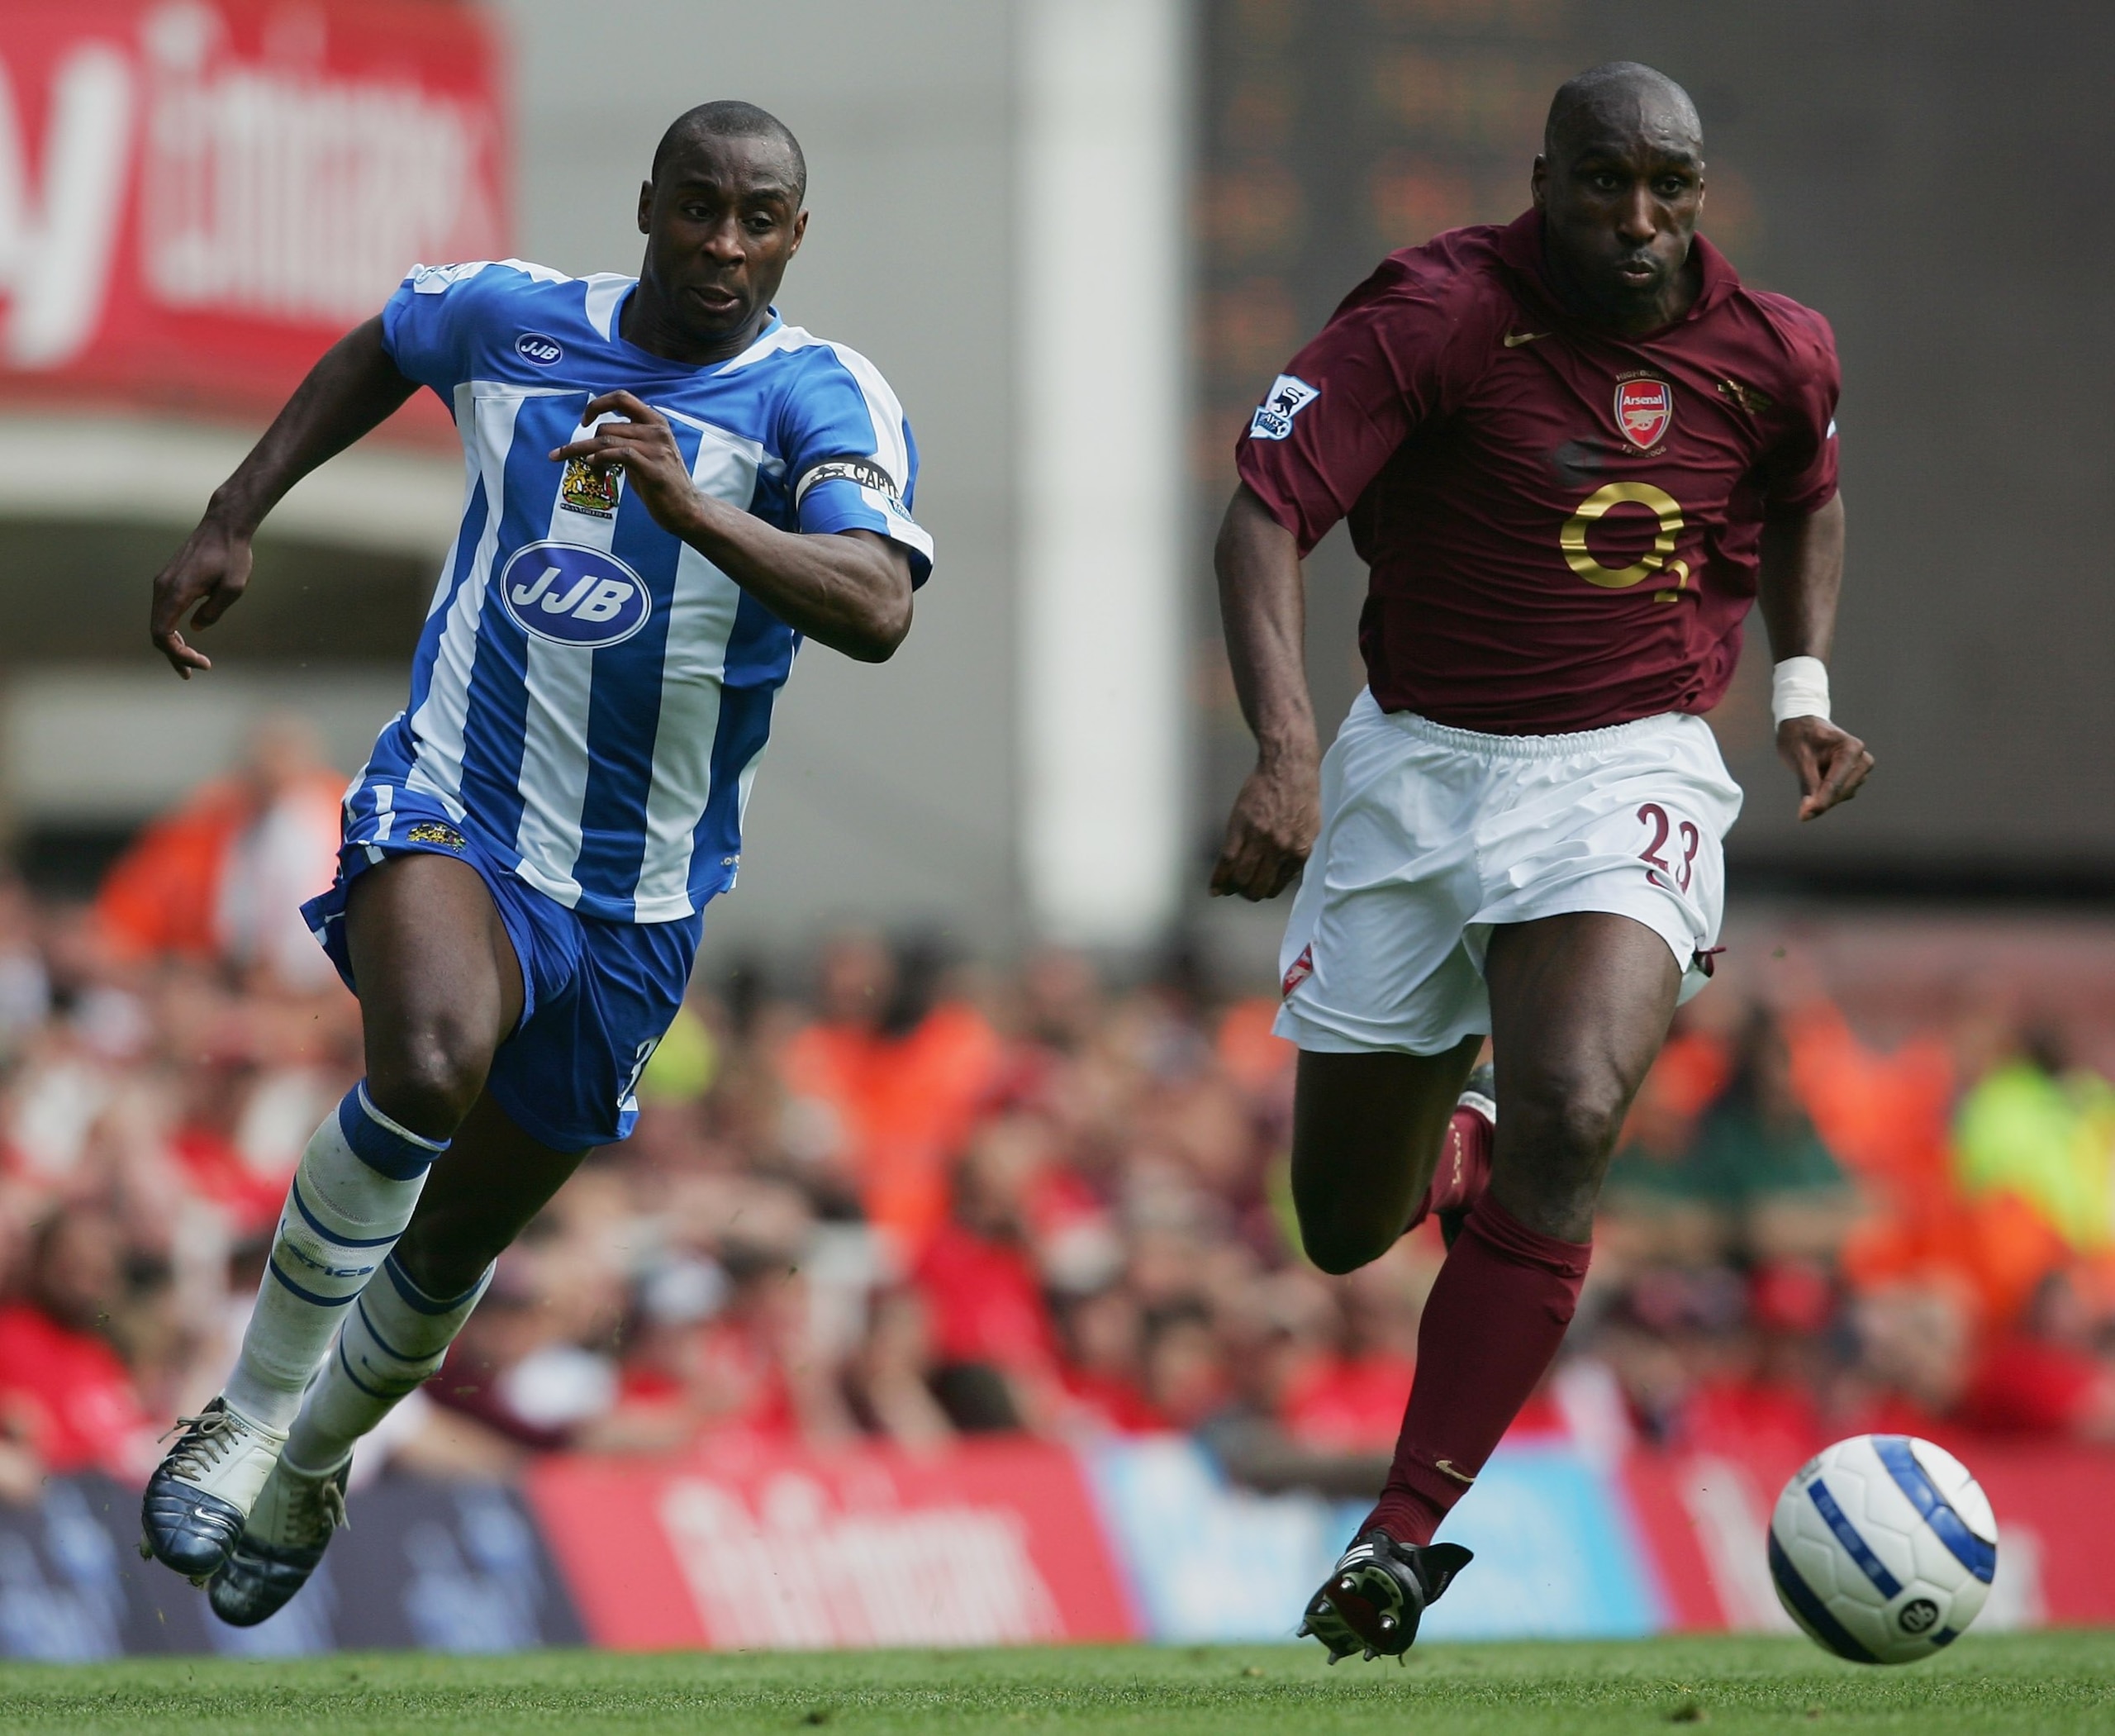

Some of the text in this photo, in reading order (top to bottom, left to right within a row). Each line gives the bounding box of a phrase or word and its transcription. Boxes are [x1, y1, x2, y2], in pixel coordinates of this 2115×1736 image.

[520, 341, 559, 360] JJB
[1616, 369, 1664, 381] HIGHBU
[1623, 394, 1662, 405] Arsenal
[511, 566, 634, 622] JJB
[1637, 802, 1699, 896] 23
